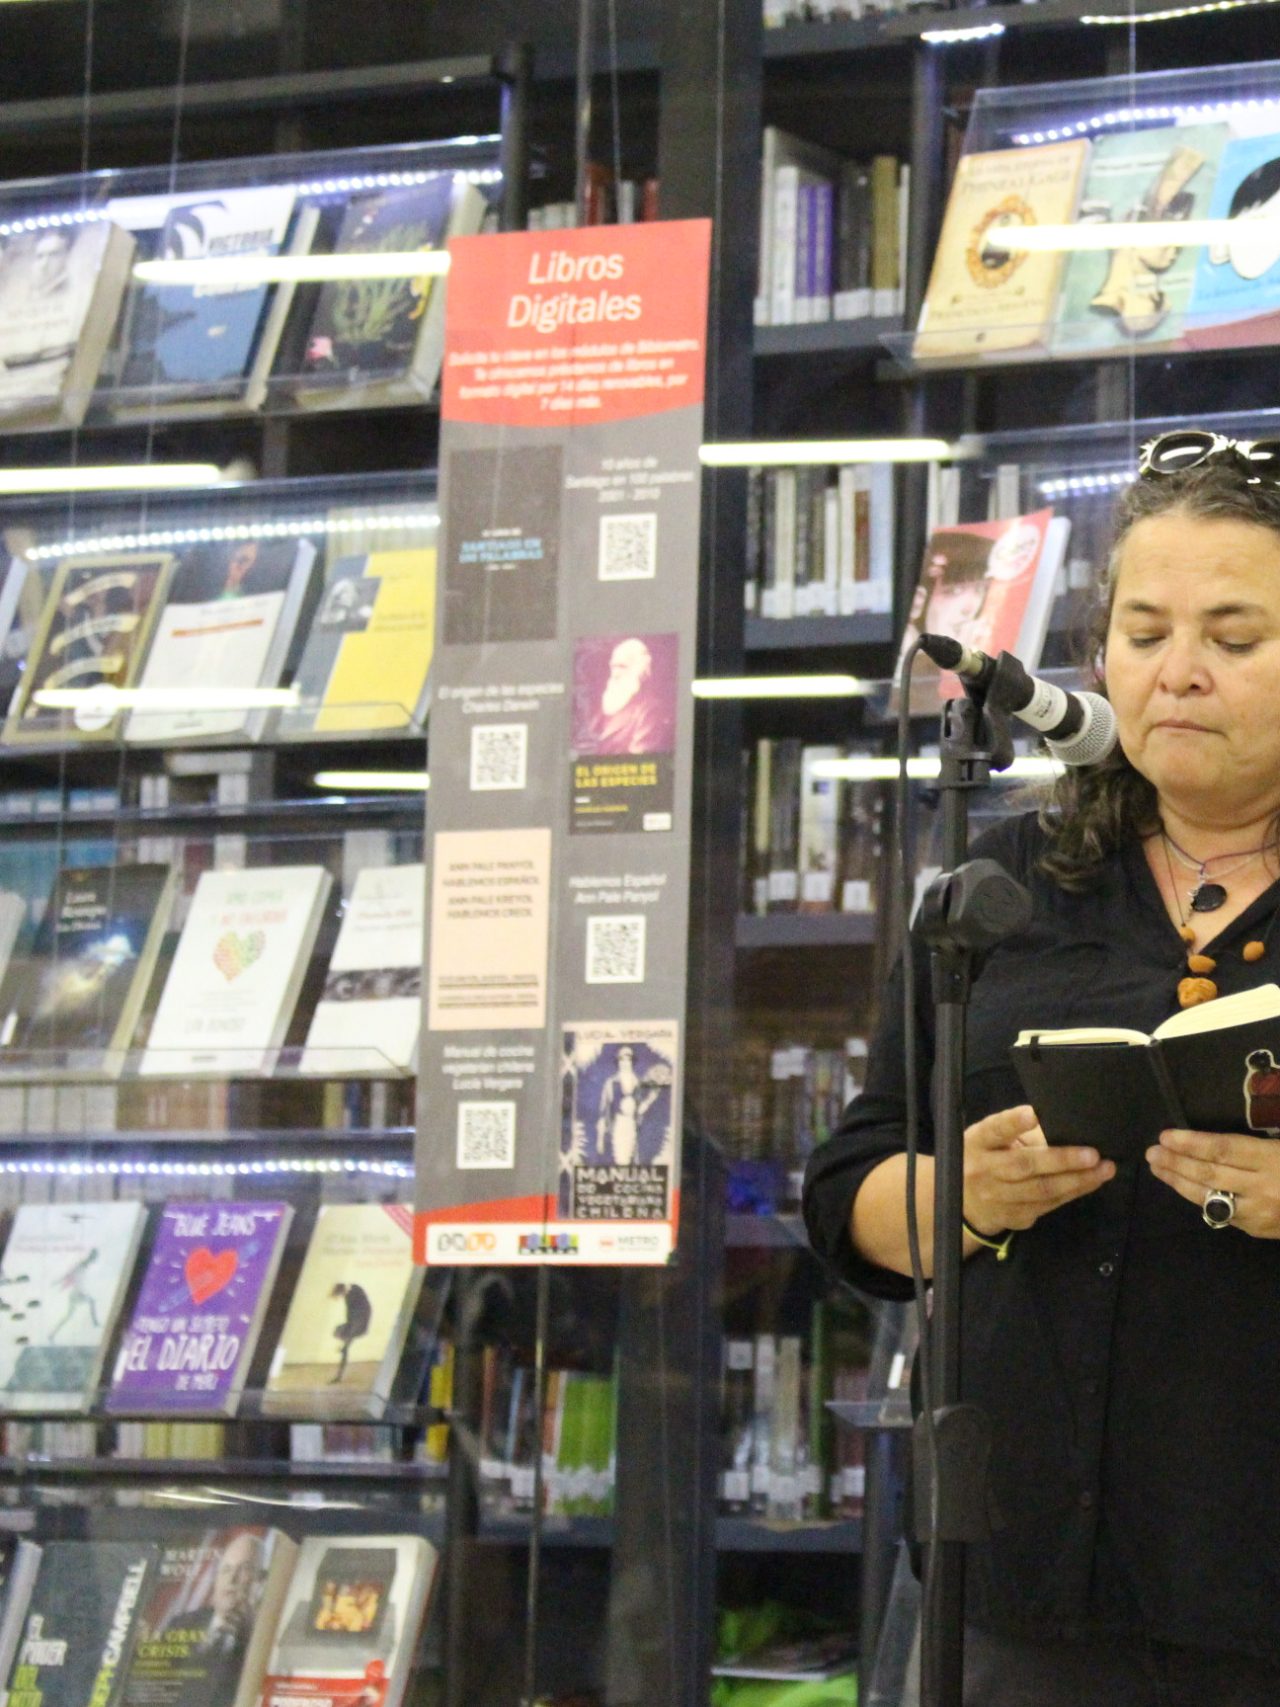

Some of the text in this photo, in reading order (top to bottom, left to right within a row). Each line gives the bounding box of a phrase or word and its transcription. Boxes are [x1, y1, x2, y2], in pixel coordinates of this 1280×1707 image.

[528, 251, 624, 285] Libros
[507, 290, 642, 334] Digitales
[576, 1166, 664, 1185] MANUAL
[127, 1333, 240, 1372] EL DIARIO
